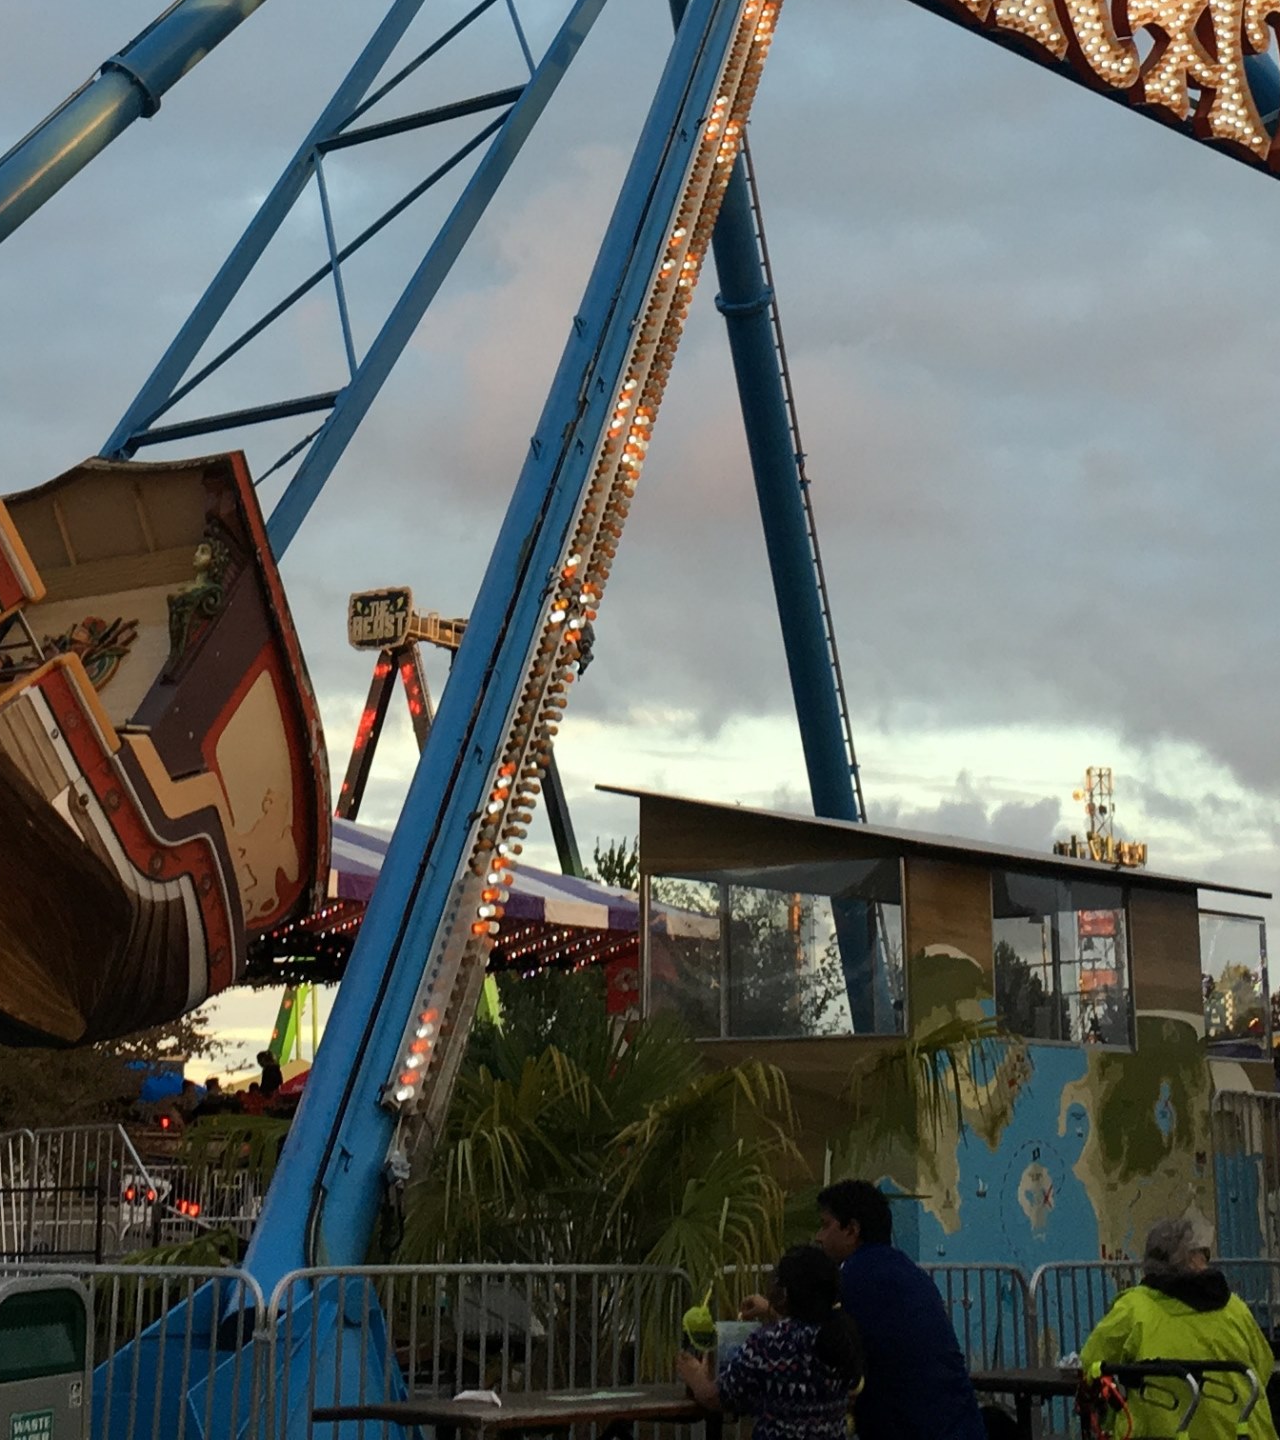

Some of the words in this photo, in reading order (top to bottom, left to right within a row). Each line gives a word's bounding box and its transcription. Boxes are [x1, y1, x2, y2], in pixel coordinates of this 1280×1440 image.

[369, 600, 391, 617] THE
[352, 611, 407, 641] BEAST
[50, 728, 60, 740] 9
[13, 1416, 51, 1435] WASTE
